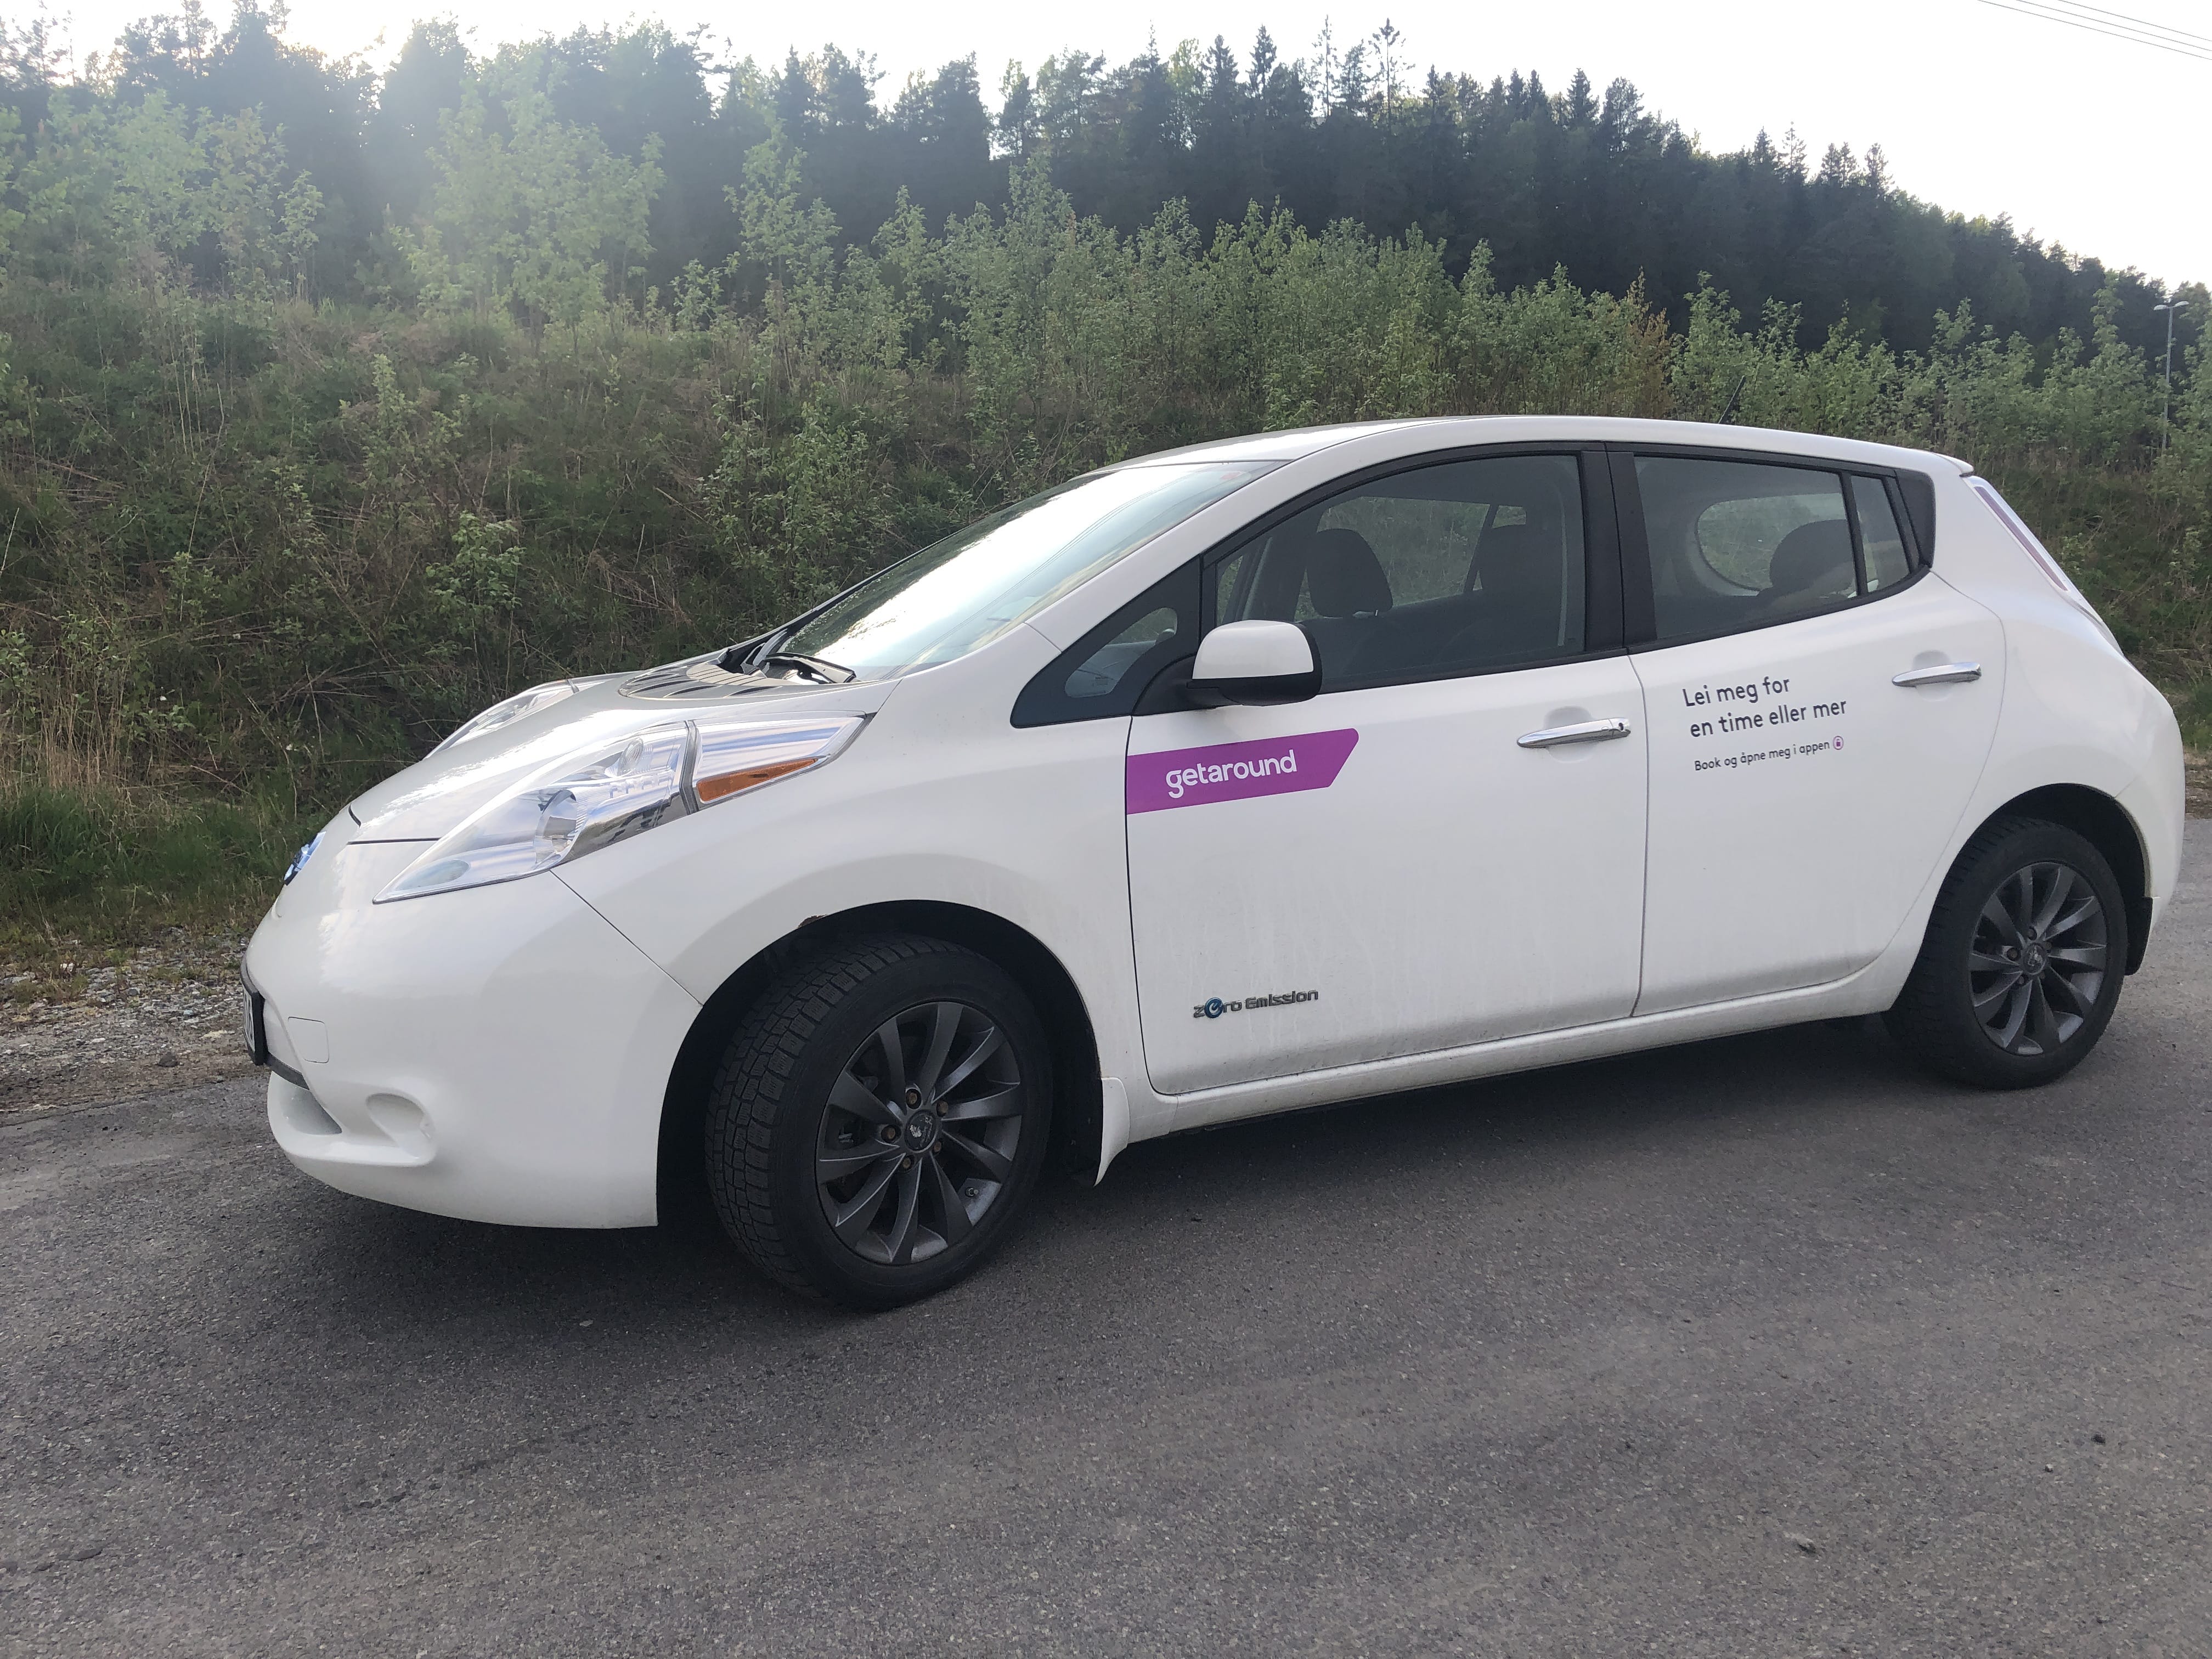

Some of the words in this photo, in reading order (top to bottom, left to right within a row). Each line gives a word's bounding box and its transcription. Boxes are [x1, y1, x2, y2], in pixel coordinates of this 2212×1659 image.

[1683, 685, 1711, 707] Lei
[1716, 684, 1759, 703] meg
[1763, 676, 1790, 695] for
[1690, 721, 1713, 737] en
[1718, 712, 1763, 732] time
[1769, 704, 1807, 725] eller
[1813, 701, 1846, 718] mer
[1695, 758, 1721, 771] Book
[1724, 756, 1737, 768] og
[1740, 752, 1766, 765] åpne
[1769, 748, 1791, 759] meg
[1793, 744, 1797, 754] i
[1799, 741, 1830, 755] appen
[1166, 749, 1297, 798] getaround
